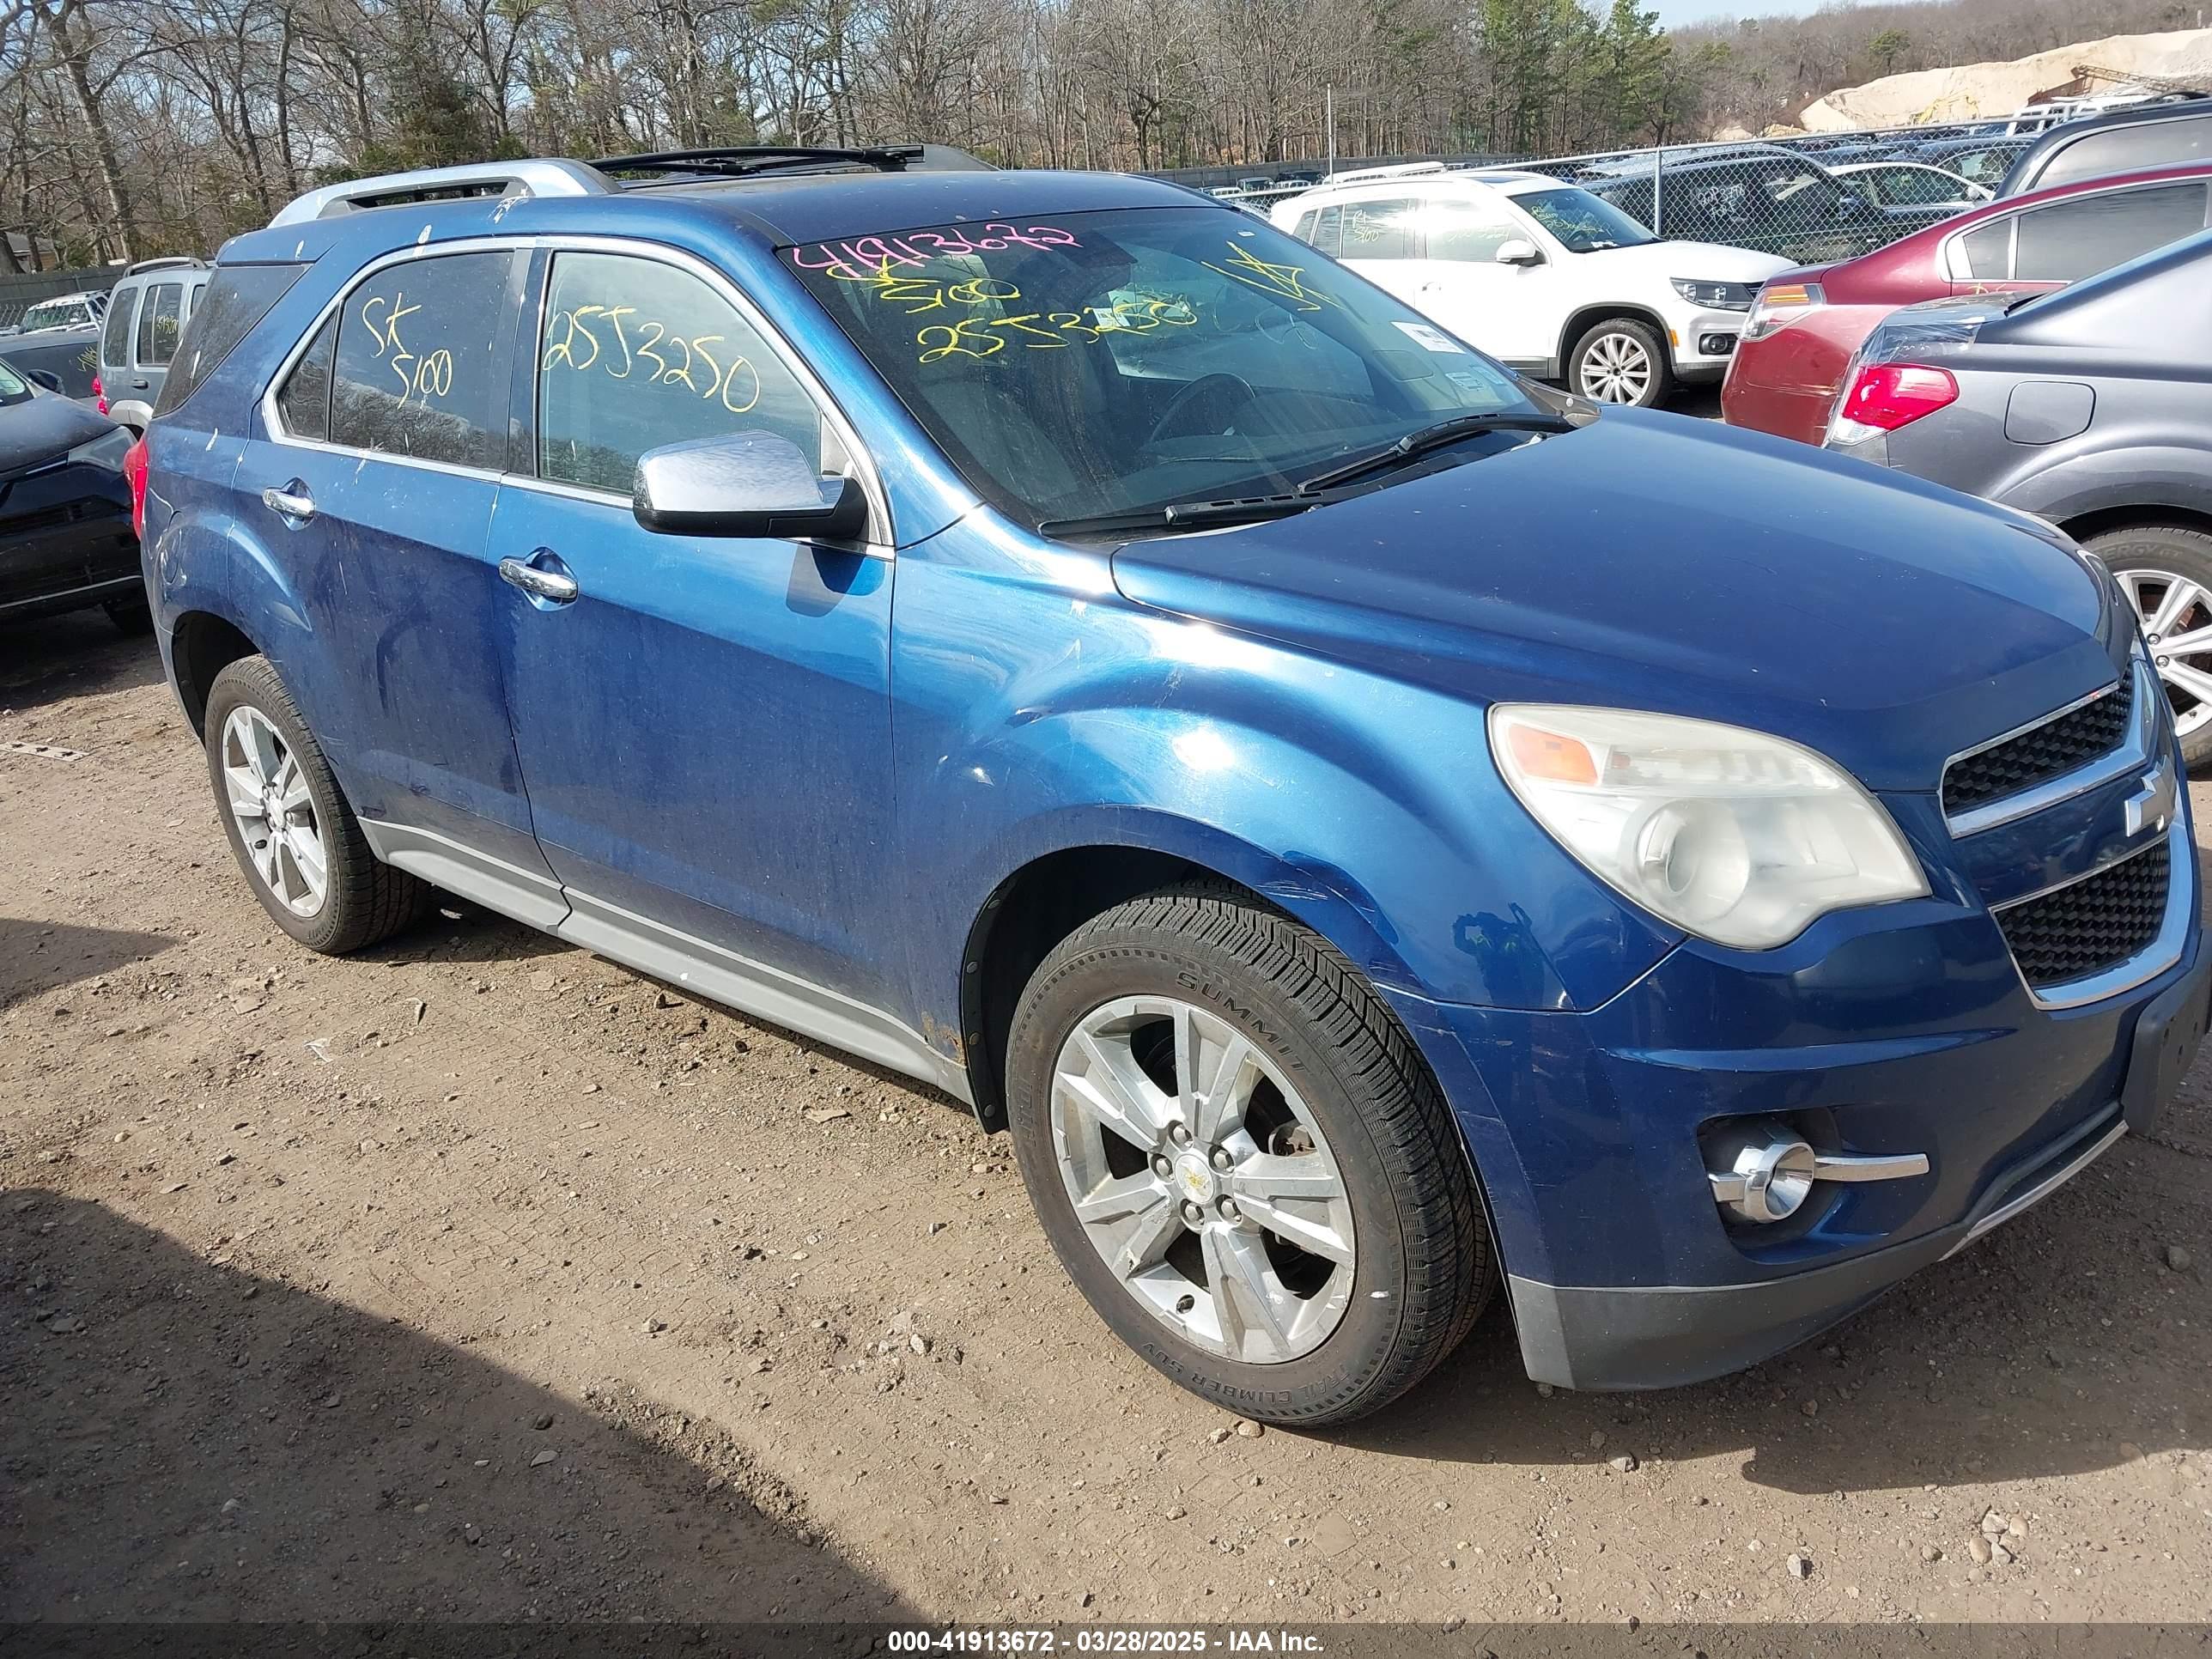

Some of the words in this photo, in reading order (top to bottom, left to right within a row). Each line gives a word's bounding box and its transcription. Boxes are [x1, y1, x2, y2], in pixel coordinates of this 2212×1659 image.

[793, 223, 1084, 277] 41913672
[391, 349, 453, 410] 5100
[543, 305, 760, 413] 25J3250
[1176, 970, 1308, 1073] SUMMIT
[1142, 1341, 1185, 1374] SUV
[1298, 1364, 1350, 1401] TRAIL
[1192, 1372, 1292, 1405] CLIMBER
